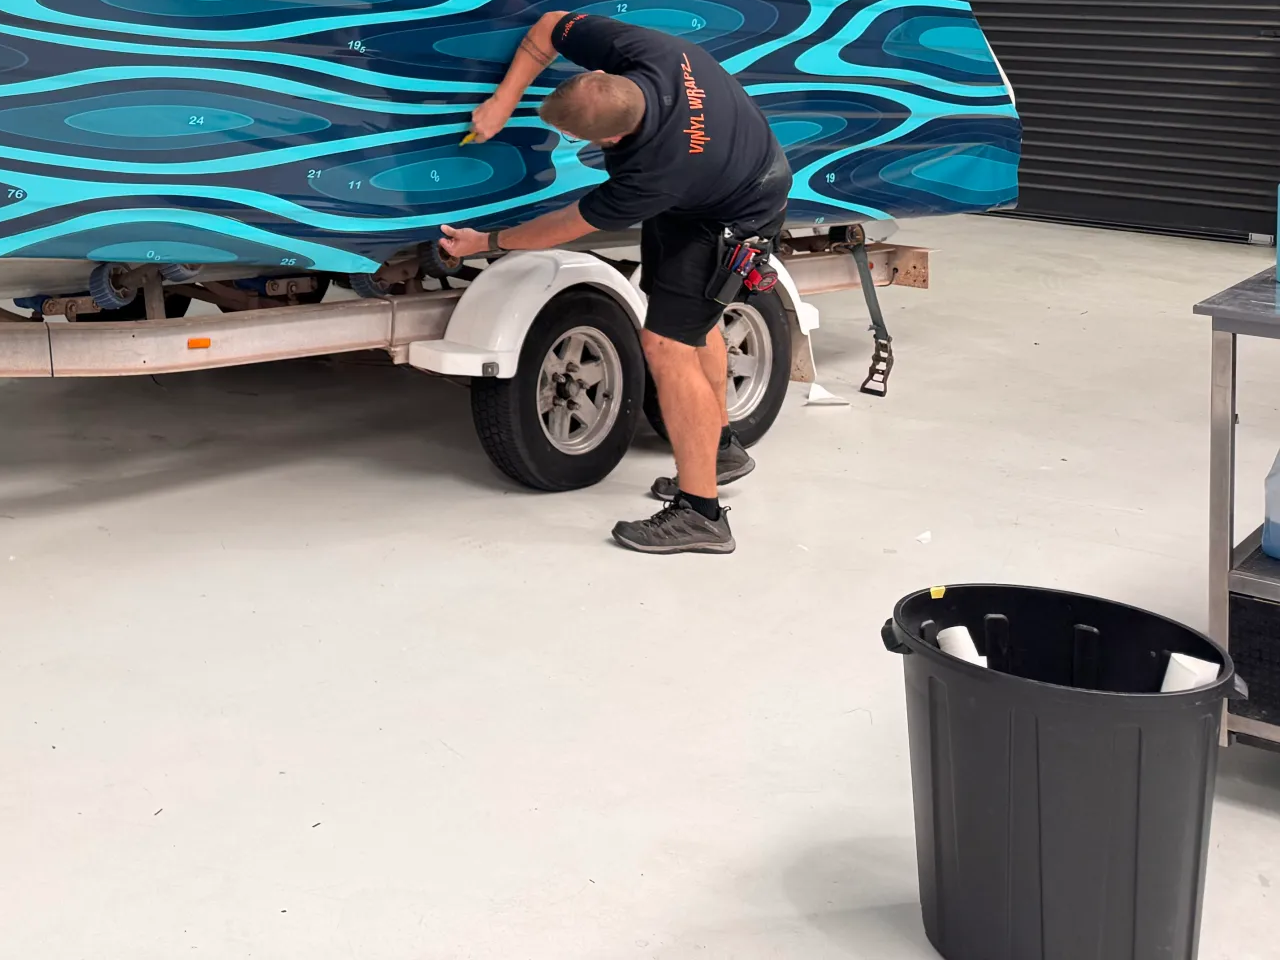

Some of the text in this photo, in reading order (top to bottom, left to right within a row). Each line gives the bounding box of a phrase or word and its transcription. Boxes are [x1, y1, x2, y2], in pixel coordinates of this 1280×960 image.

[616, 3, 628, 13] 12
[680, 52, 711, 154] VINYL WRAPZ
[188, 115, 205, 126] 24
[307, 169, 322, 179] 21
[825, 172, 836, 183] 19
[348, 180, 362, 190] 11
[7, 188, 24, 199] 76
[280, 258, 297, 266] 25
